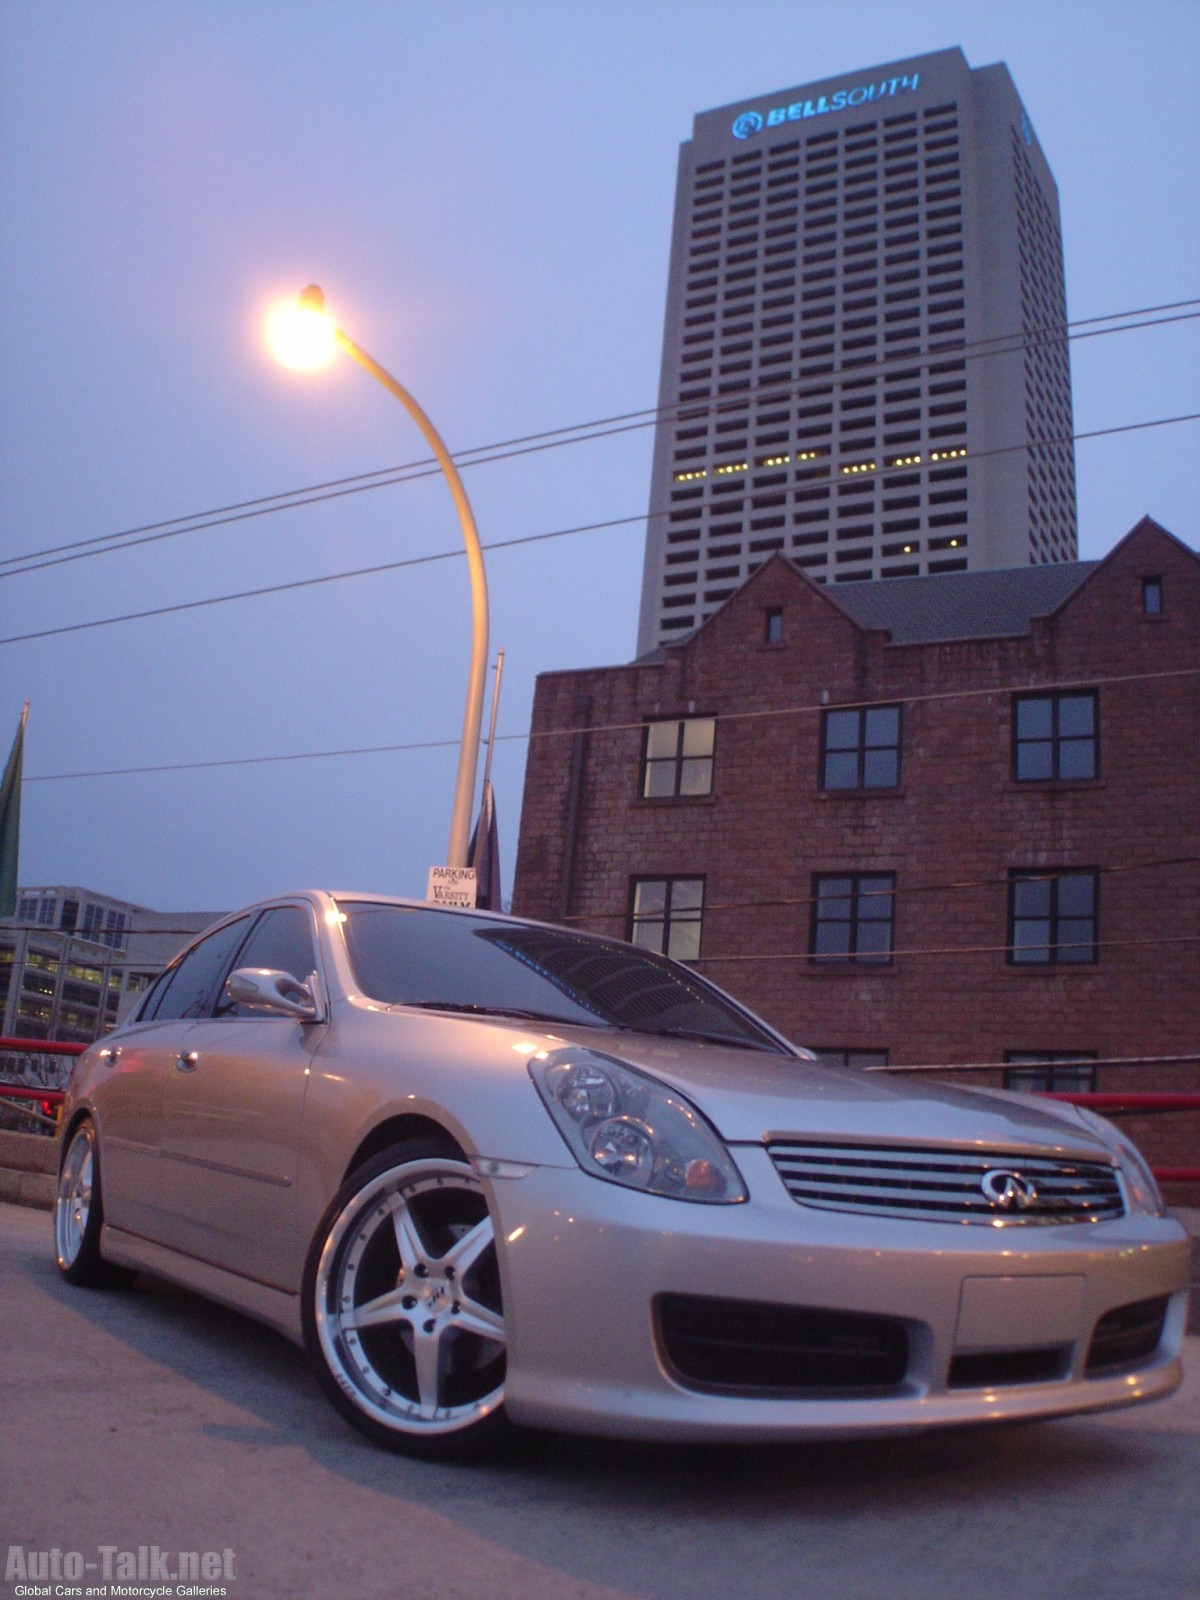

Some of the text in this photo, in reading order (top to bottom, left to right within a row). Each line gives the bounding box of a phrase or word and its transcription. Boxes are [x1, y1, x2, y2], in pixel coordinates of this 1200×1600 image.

[766, 73, 920, 128] BELLSOUTH
[433, 868, 475, 880] PARKING
[433, 885, 469, 901] VARSITY
